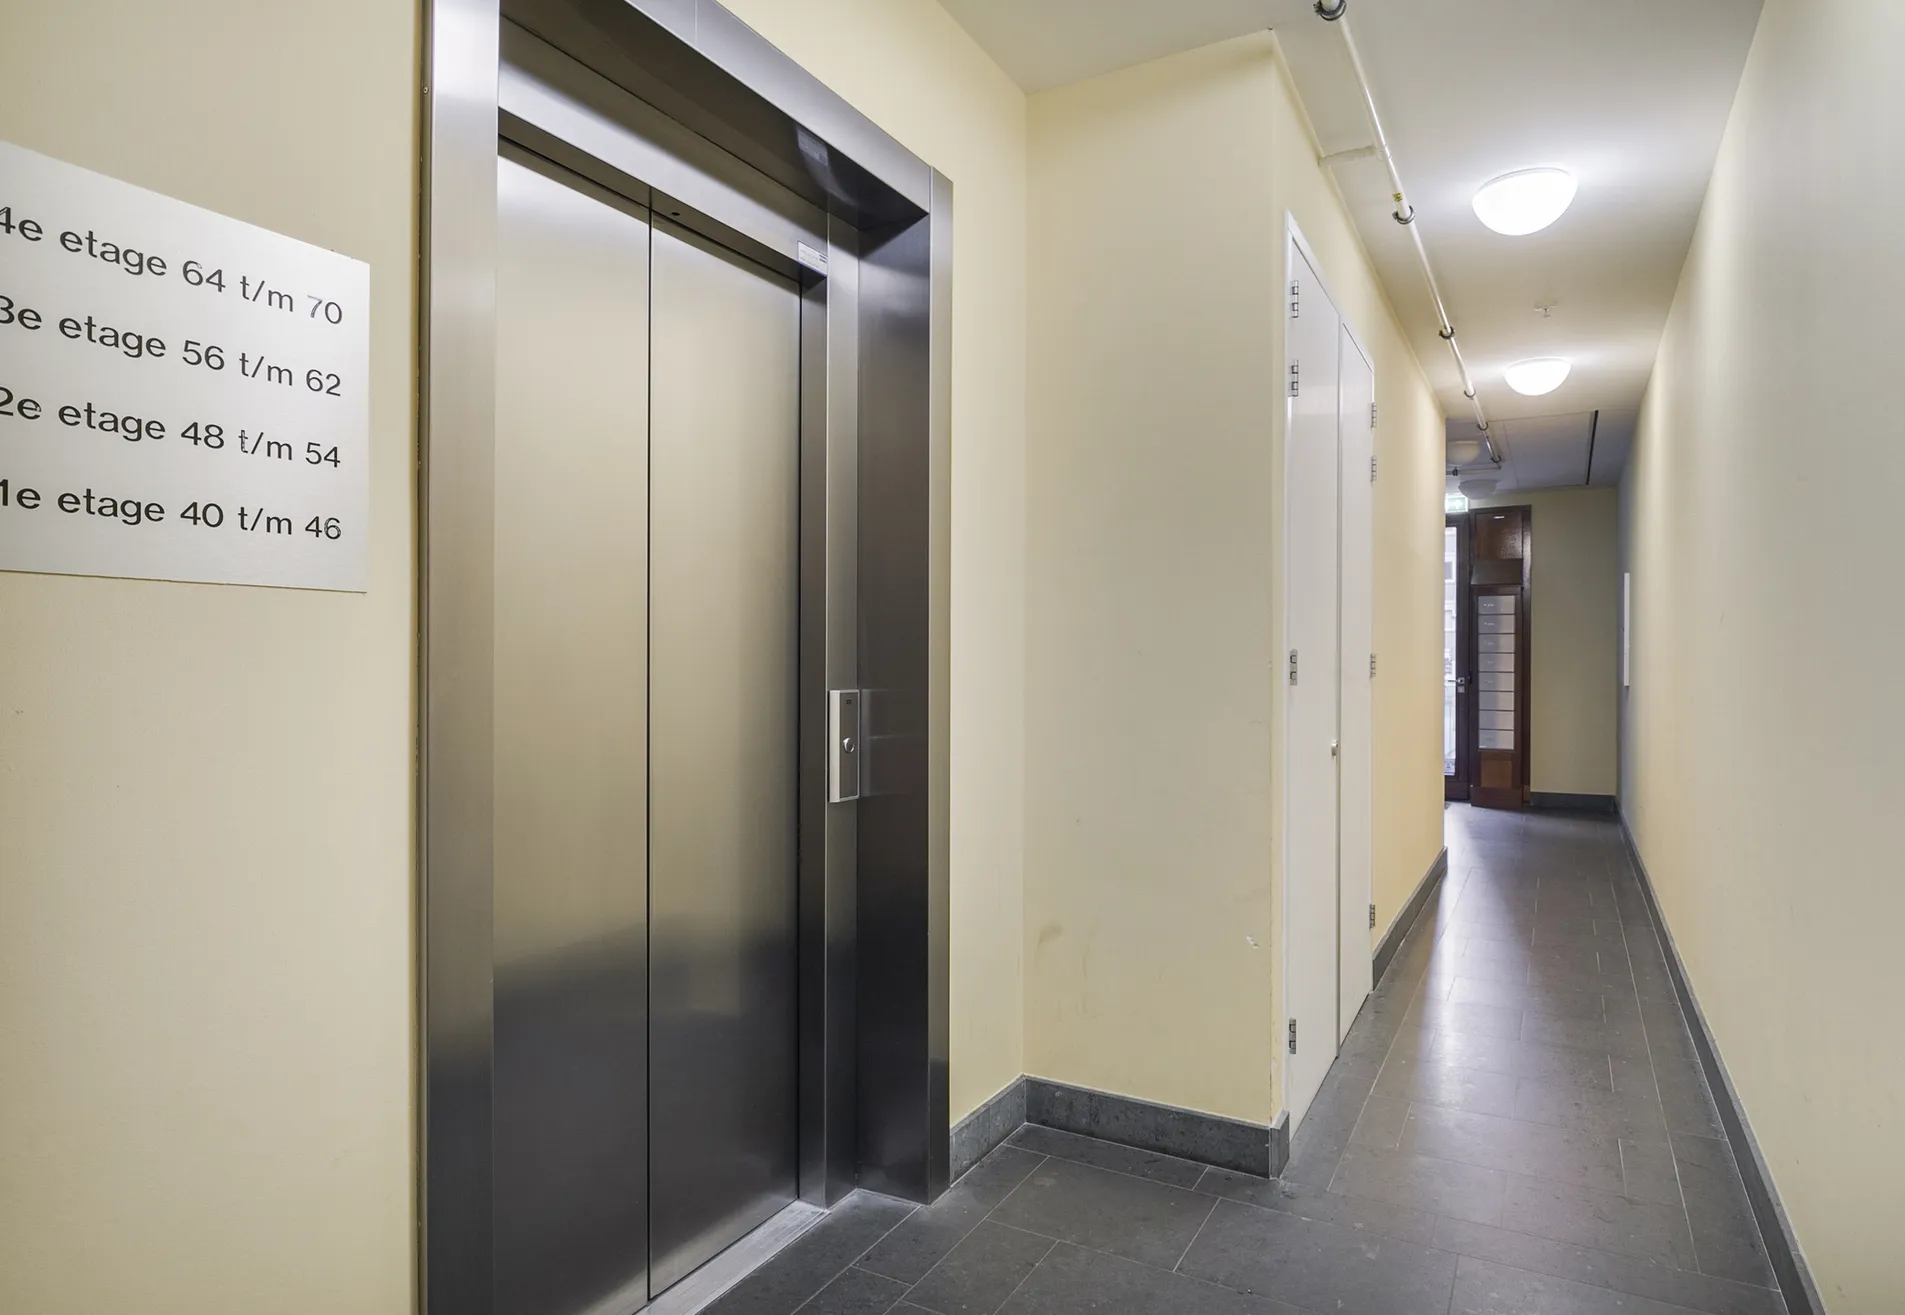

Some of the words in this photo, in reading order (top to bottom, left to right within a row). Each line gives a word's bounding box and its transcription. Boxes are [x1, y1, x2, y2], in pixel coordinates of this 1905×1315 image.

[0, 206, 43, 241] 4e
[60, 230, 167, 276] etage
[182, 260, 226, 293] 64
[239, 275, 294, 313] t/m
[306, 295, 343, 325] 70
[0, 294, 43, 331] 3e
[58, 316, 167, 358] etage
[182, 340, 225, 371] 56
[238, 353, 293, 387] t/m
[305, 369, 342, 397] 62
[0, 386, 43, 421] 2e
[58, 402, 166, 442] etage
[180, 422, 225, 450] 48
[237, 429, 293, 461] t/m
[305, 442, 342, 469] 54
[57, 488, 166, 526] etage
[180, 502, 225, 529] 40
[237, 506, 293, 536] t/m
[304, 516, 343, 541] 46
